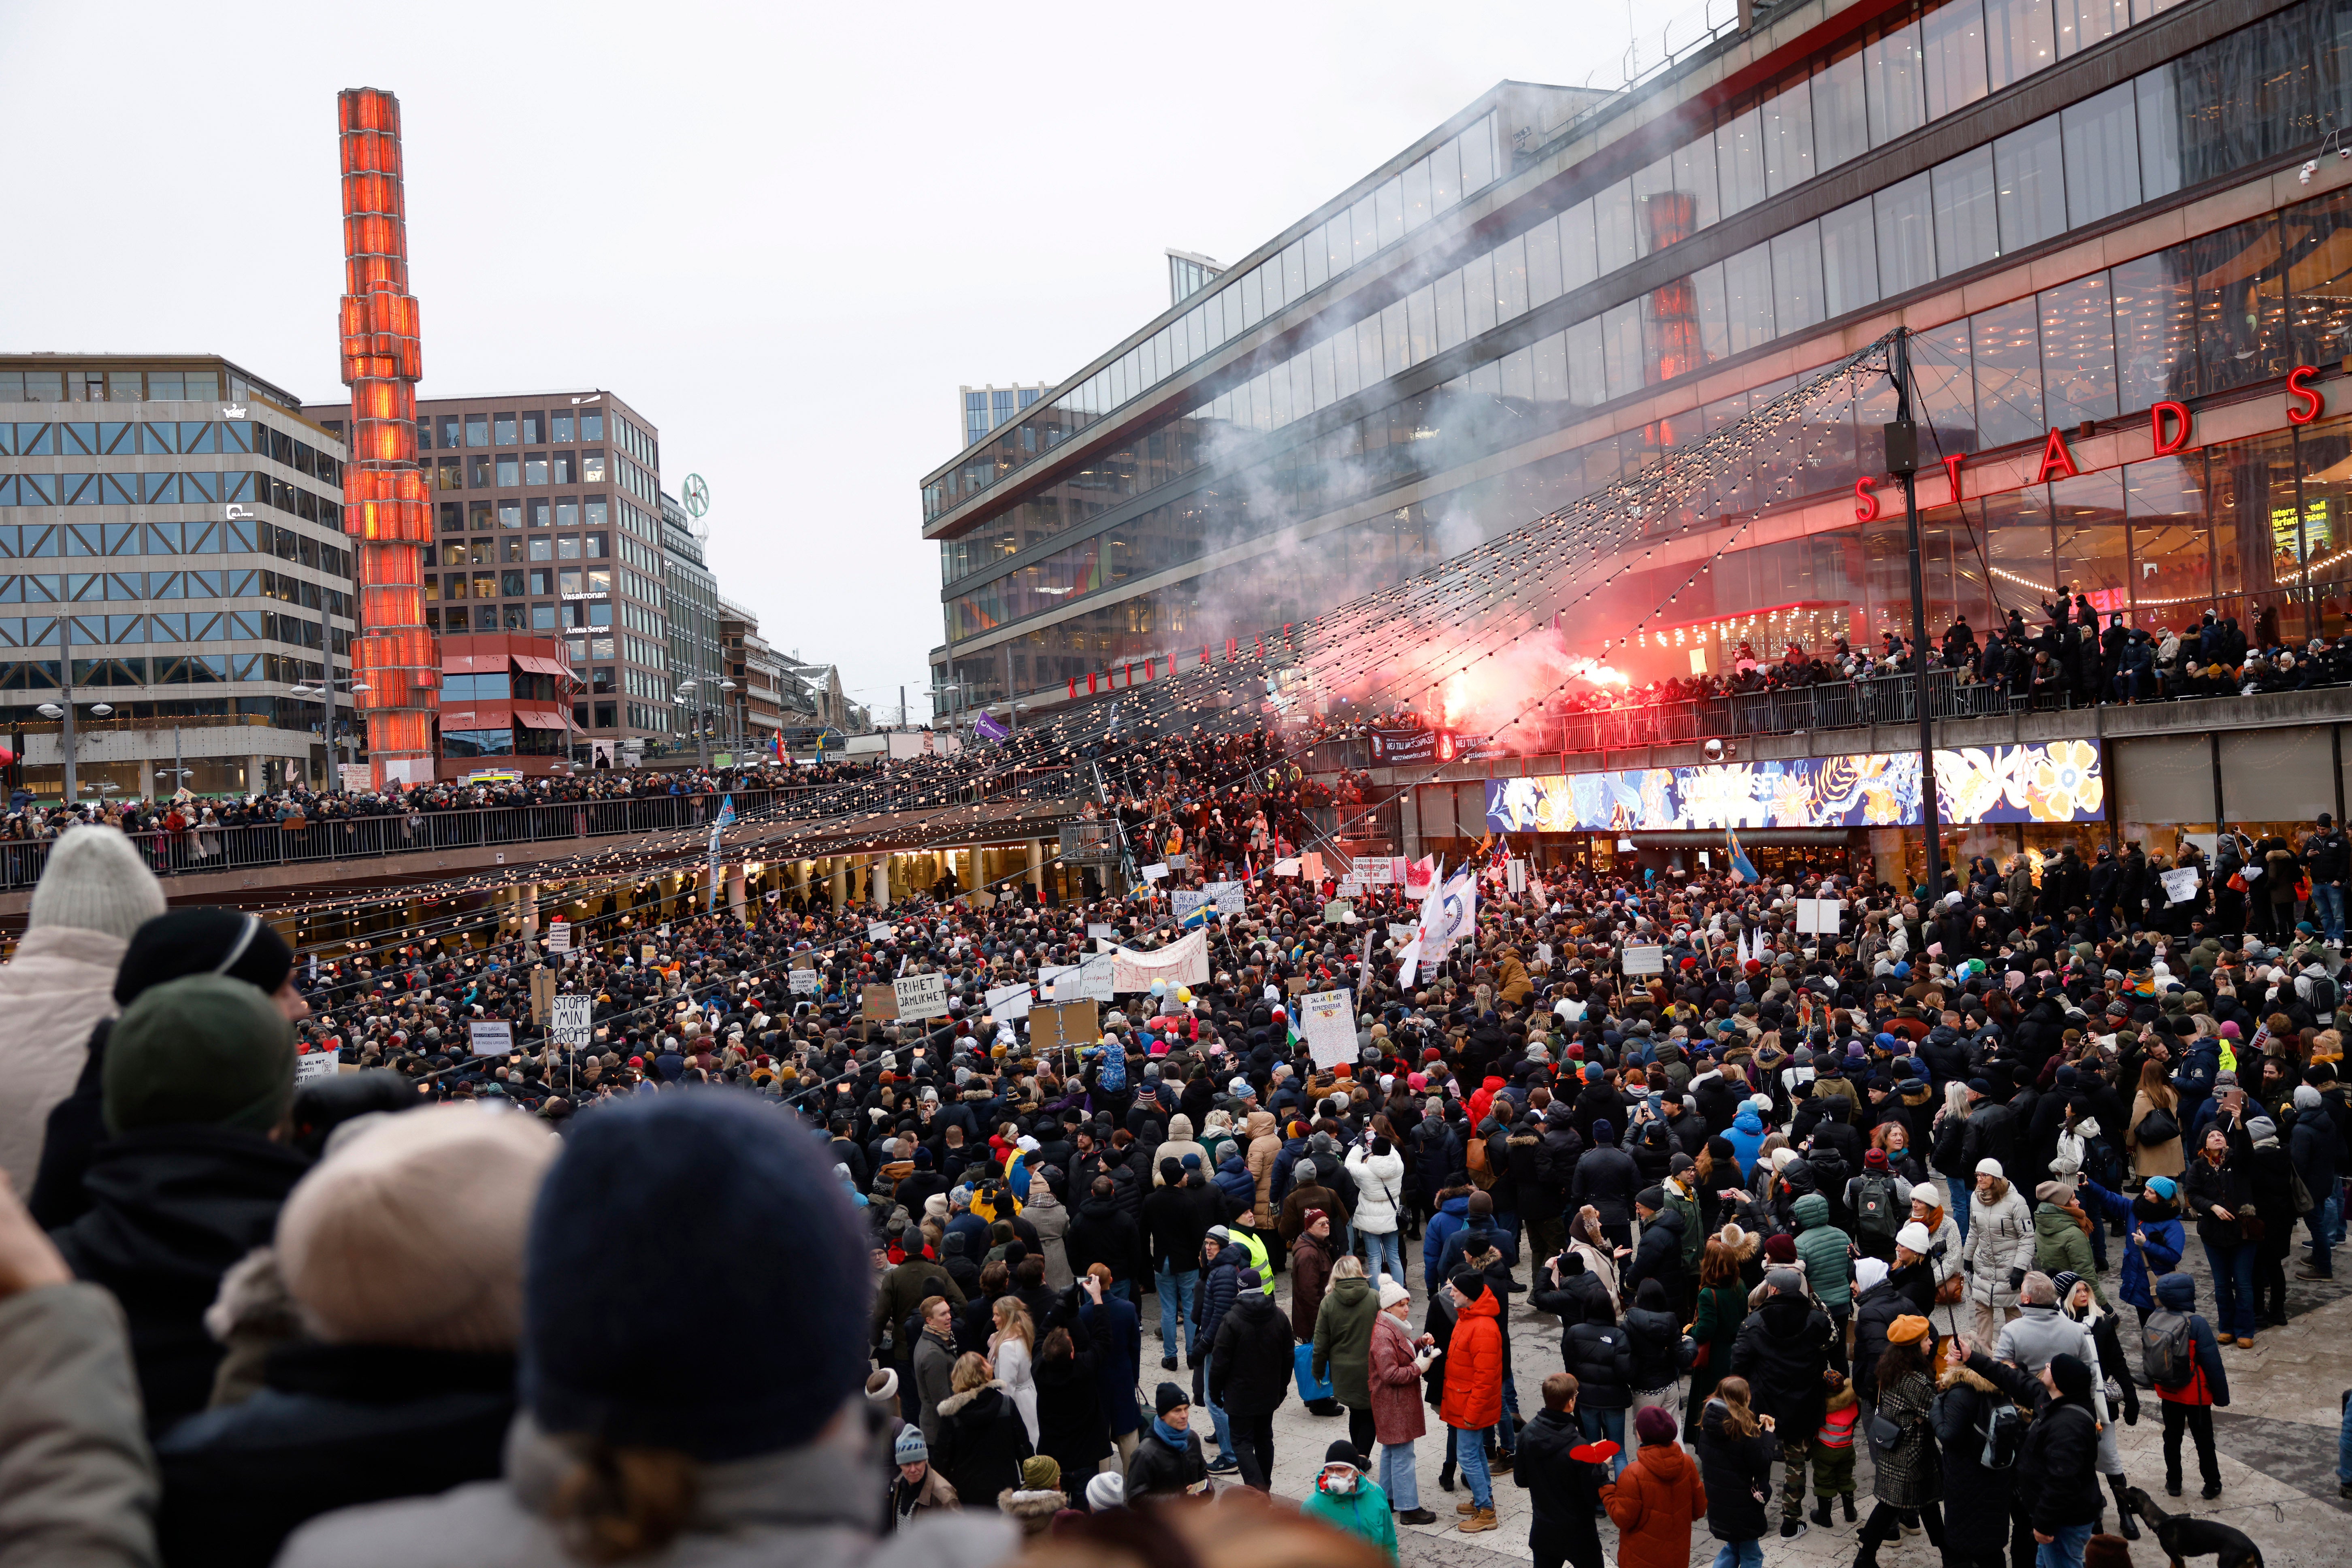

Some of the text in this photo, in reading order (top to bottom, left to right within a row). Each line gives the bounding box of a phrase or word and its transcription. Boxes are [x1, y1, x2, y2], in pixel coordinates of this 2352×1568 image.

[587, 471, 603, 481] EY
[561, 592, 606, 600] Vasakronan
[1067, 616, 1323, 698] KULTURHUSET
[1405, 735, 1435, 749] VACCINPASS!
[1456, 738, 1476, 748] NEJ TILL
[1392, 750, 1431, 761] MOTSTÅNDSRÖRELSEN.SE
[2163, 869, 2192, 882] VACCINPASS
[1173, 892, 1198, 904] LÄKAR
[1216, 897, 1243, 905] SÄGER
[1453, 896, 1462, 917] CHRISTUS
[1084, 956, 1110, 969] Stoppa
[897, 978, 935, 995] FRIHET
[1083, 986, 1110, 995] Dumheter
[554, 996, 589, 1010] STOPP
[899, 990, 946, 1007] JÄMLIKHET
[1312, 1003, 1341, 1012] REPRESENTERAR
[559, 1010, 582, 1025] MIN
[551, 1027, 590, 1044] KROPP
[2253, 1031, 2267, 1048] NEJ!
